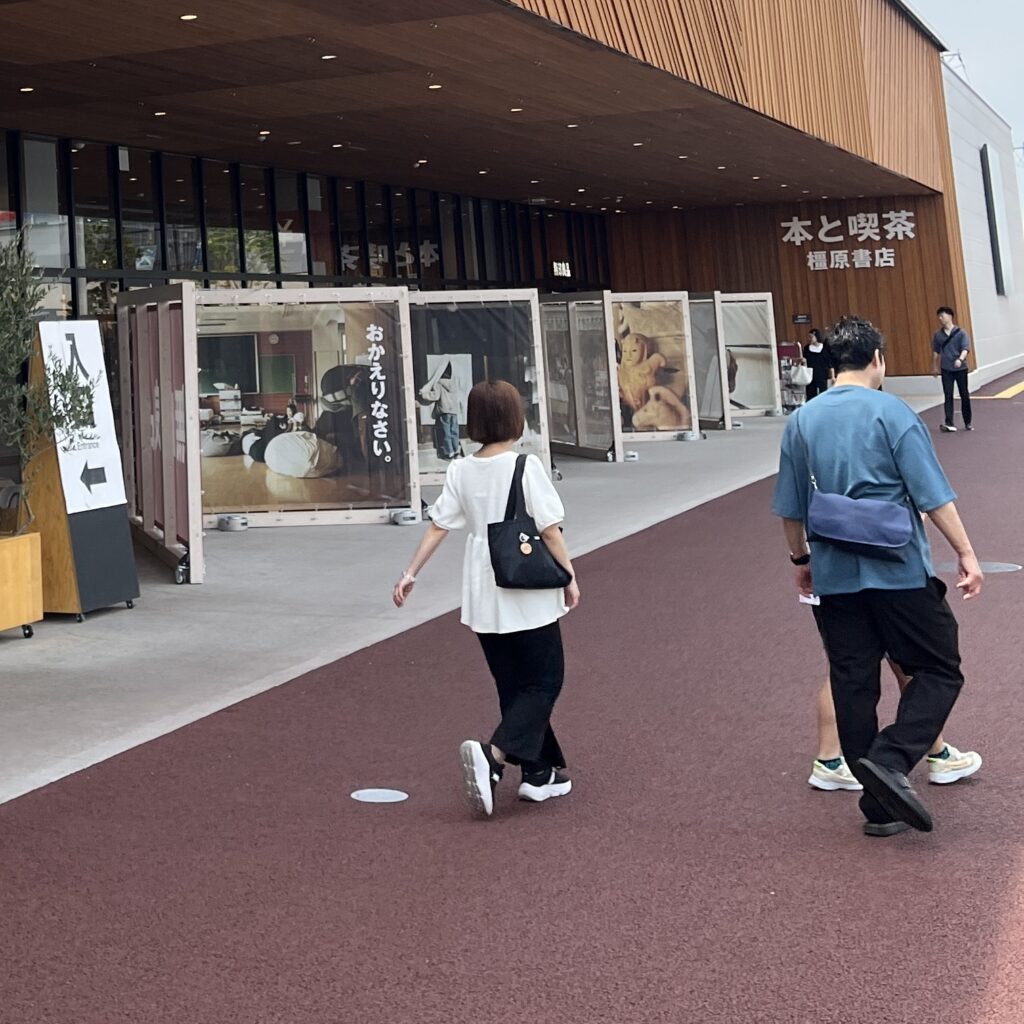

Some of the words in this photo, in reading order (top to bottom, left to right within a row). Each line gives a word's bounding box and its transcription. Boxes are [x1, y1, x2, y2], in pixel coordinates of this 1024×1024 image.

[780, 209, 916, 246] 本と喫茶
[806, 247, 896, 271] 橿原書店
[365, 323, 392, 463] おかえりなさい。
